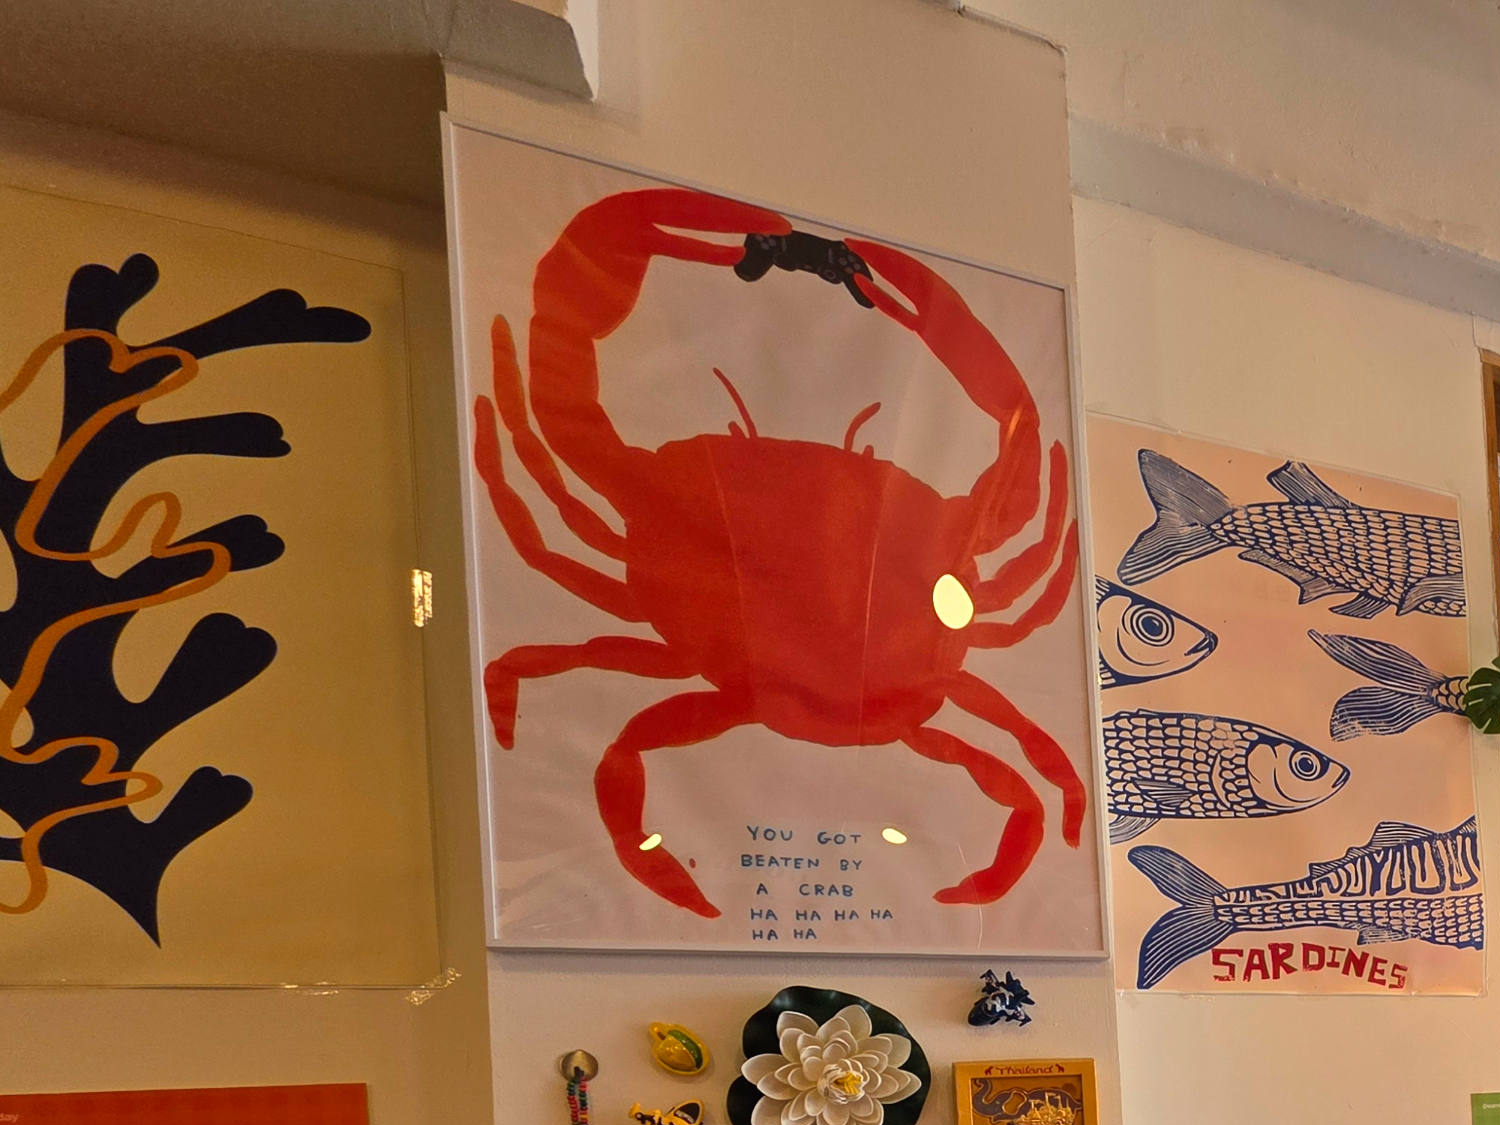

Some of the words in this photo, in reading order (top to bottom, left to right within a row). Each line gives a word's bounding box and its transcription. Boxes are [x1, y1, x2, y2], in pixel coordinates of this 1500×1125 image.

[747, 825, 793, 841] YOU
[817, 831, 861, 844] GOT
[741, 854, 820, 869] BEATEN
[840, 859, 862, 871] BY
[756, 883, 768, 895] A
[799, 883, 854, 897] CRAB
[750, 908, 778, 920] HA
[795, 909, 821, 920] HA
[834, 909, 859, 921] HA
[870, 909, 893, 920] HA
[752, 929, 778, 940] HA
[793, 928, 817, 939] HA
[1211, 942, 1408, 989] SARDINES
[995, 1064, 1053, 1075] Thailand
